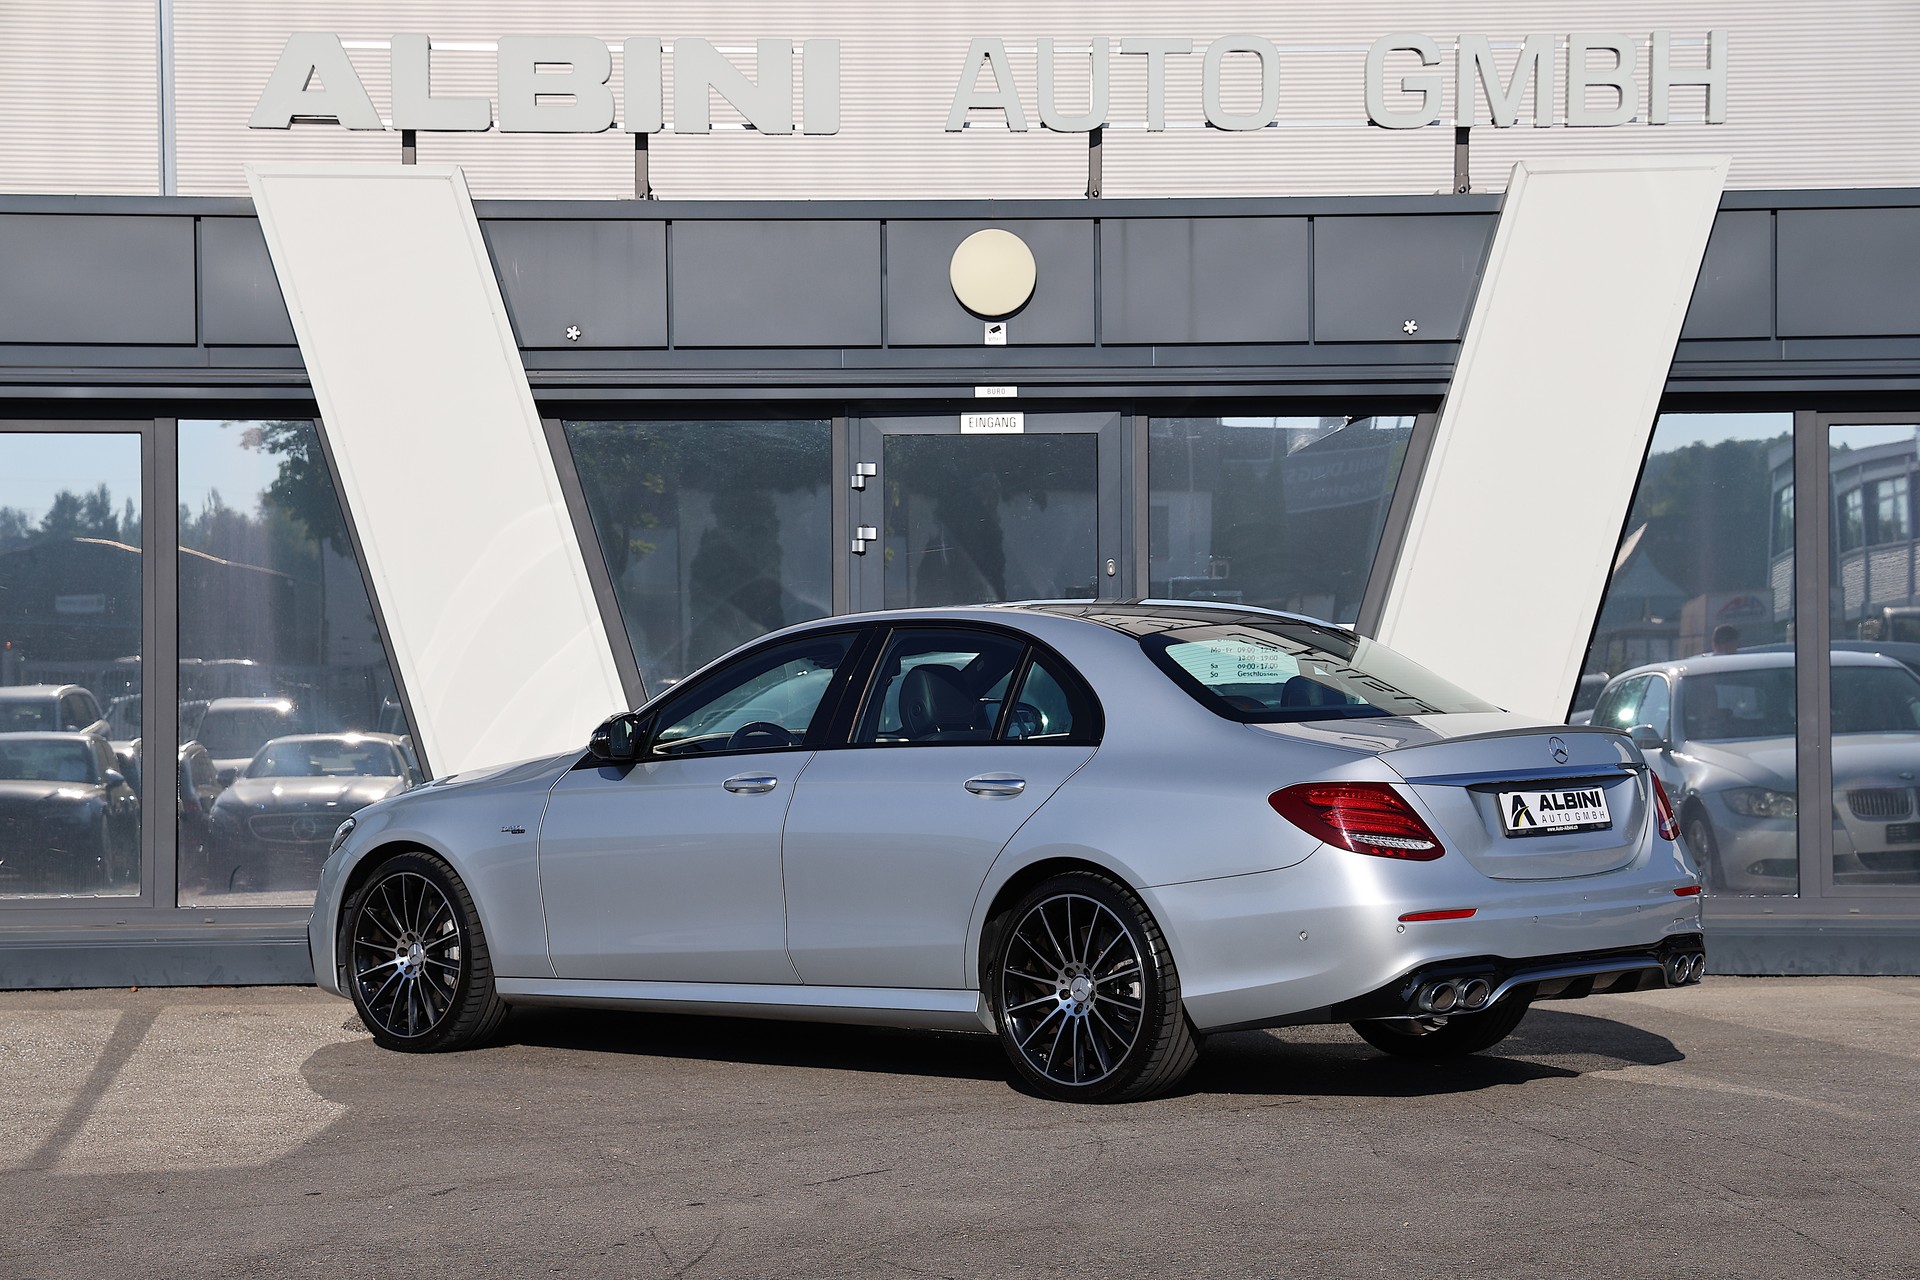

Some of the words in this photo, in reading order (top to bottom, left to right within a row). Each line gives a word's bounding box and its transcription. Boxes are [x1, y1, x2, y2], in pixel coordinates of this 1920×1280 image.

[247, 32, 840, 135] ALBINI
[944, 35, 1281, 133] AUTO
[1364, 29, 1729, 129] GMBH
[969, 416, 1017, 428] EINGANG
[1539, 791, 1602, 811] ALBINI
[1541, 812, 1571, 824] AUTO
[1575, 810, 1606, 821] GMBH
